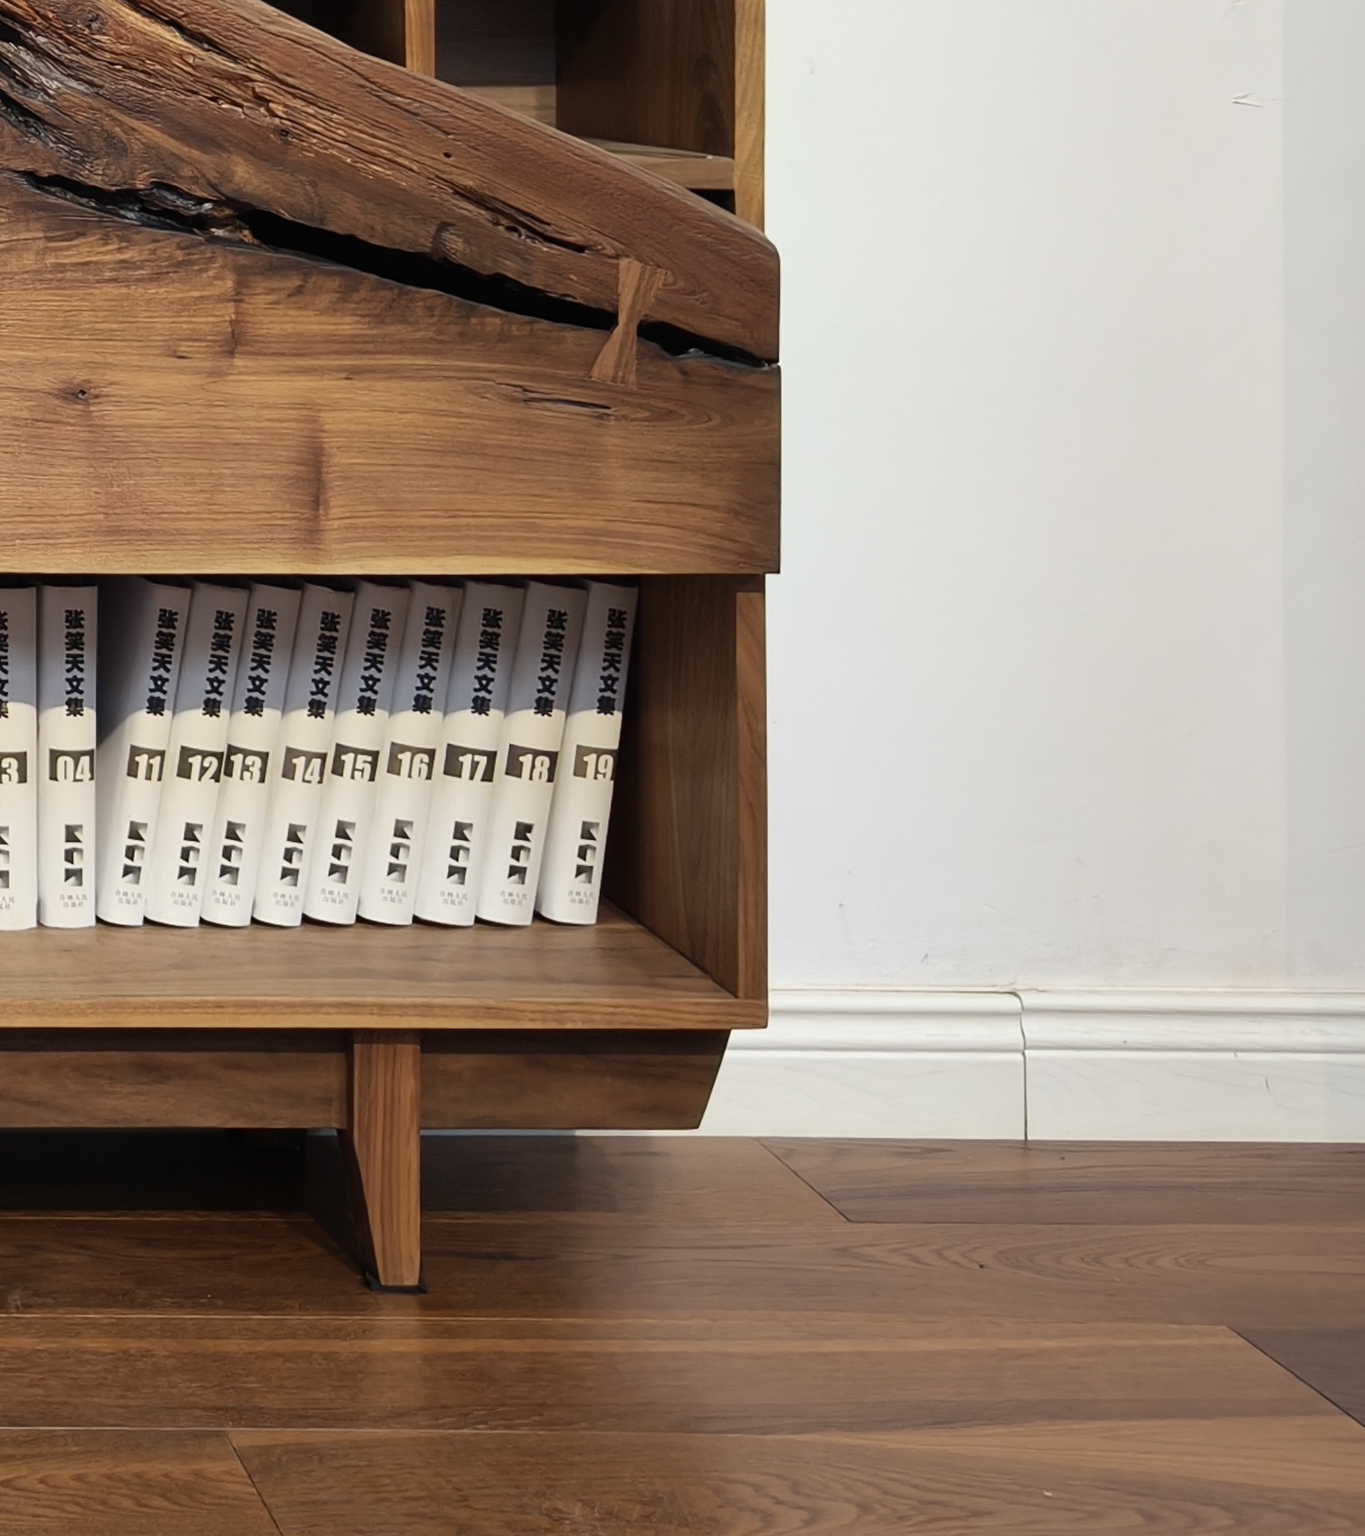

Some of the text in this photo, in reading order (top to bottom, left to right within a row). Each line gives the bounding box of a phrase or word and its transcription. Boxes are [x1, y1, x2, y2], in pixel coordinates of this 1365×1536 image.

[64, 609, 85, 717] 张笑天文集
[146, 608, 179, 717] 张笑天文集
[202, 610, 235, 718] 张笑天文集
[244, 608, 278, 717] 张笑天文集
[307, 611, 341, 719] 张笑天文集
[356, 608, 392, 716] 张笑天文集
[412, 606, 446, 714] 张笑天文集
[471, 608, 503, 716] 张笑天文集
[534, 609, 568, 717] 张笑天文集
[597, 608, 628, 716] 张笑天文集
[57, 755, 91, 782] 04
[135, 754, 161, 781] 11
[188, 755, 218, 782] 12
[230, 753, 262, 783] 13
[292, 756, 322, 784] 14
[341, 753, 372, 782] 15
[398, 751, 430, 780] 16
[459, 753, 487, 782] 17
[519, 754, 550, 783] 18
[583, 753, 614, 781] 19
